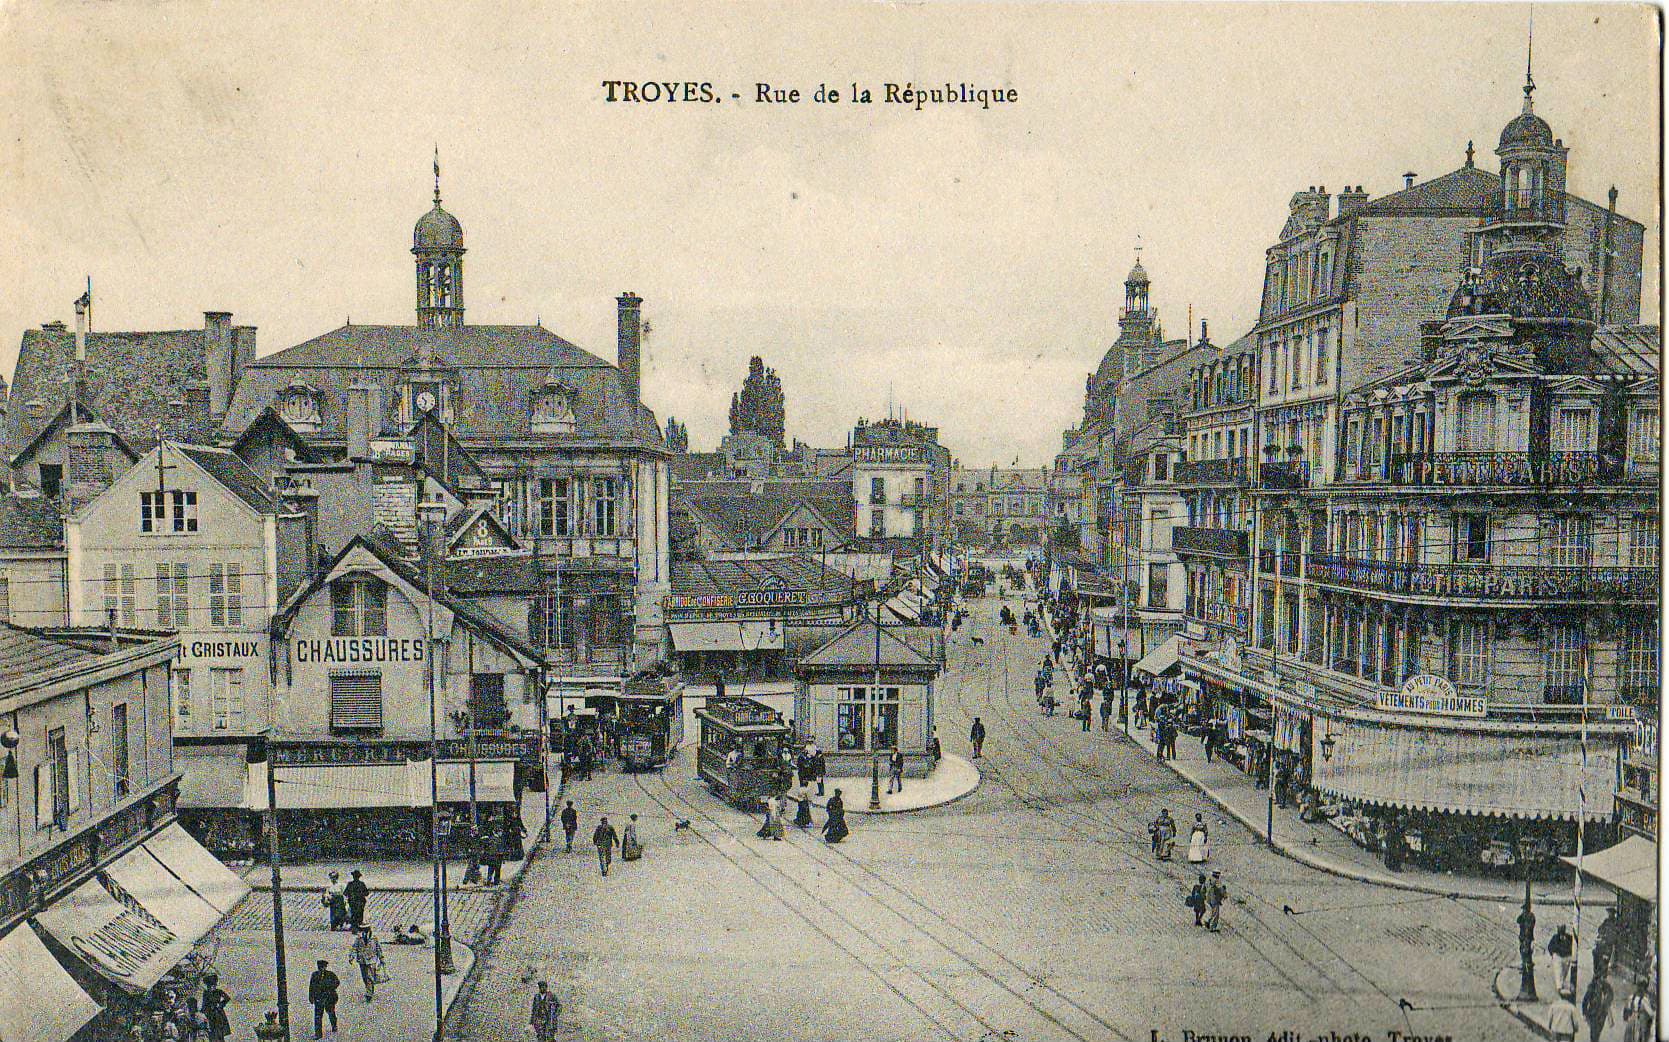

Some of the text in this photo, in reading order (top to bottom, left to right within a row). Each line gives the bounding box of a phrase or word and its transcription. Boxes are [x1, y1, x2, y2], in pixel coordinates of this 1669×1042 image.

[854, 447, 919, 461] PHARMACIE
[1421, 461, 1483, 484] PETIT
[1503, 461, 1582, 484] PARIS
[477, 519, 489, 539] 8
[1411, 572, 1467, 594] PETIT
[1484, 572, 1559, 596] PARIS
[297, 638, 425, 663] CHAUSSURES
[1414, 675, 1433, 687] PETIT
[1434, 677, 1454, 697] PARIS
[1441, 698, 1485, 713] HOMMES
[448, 741, 528, 757] CHUSSURES
